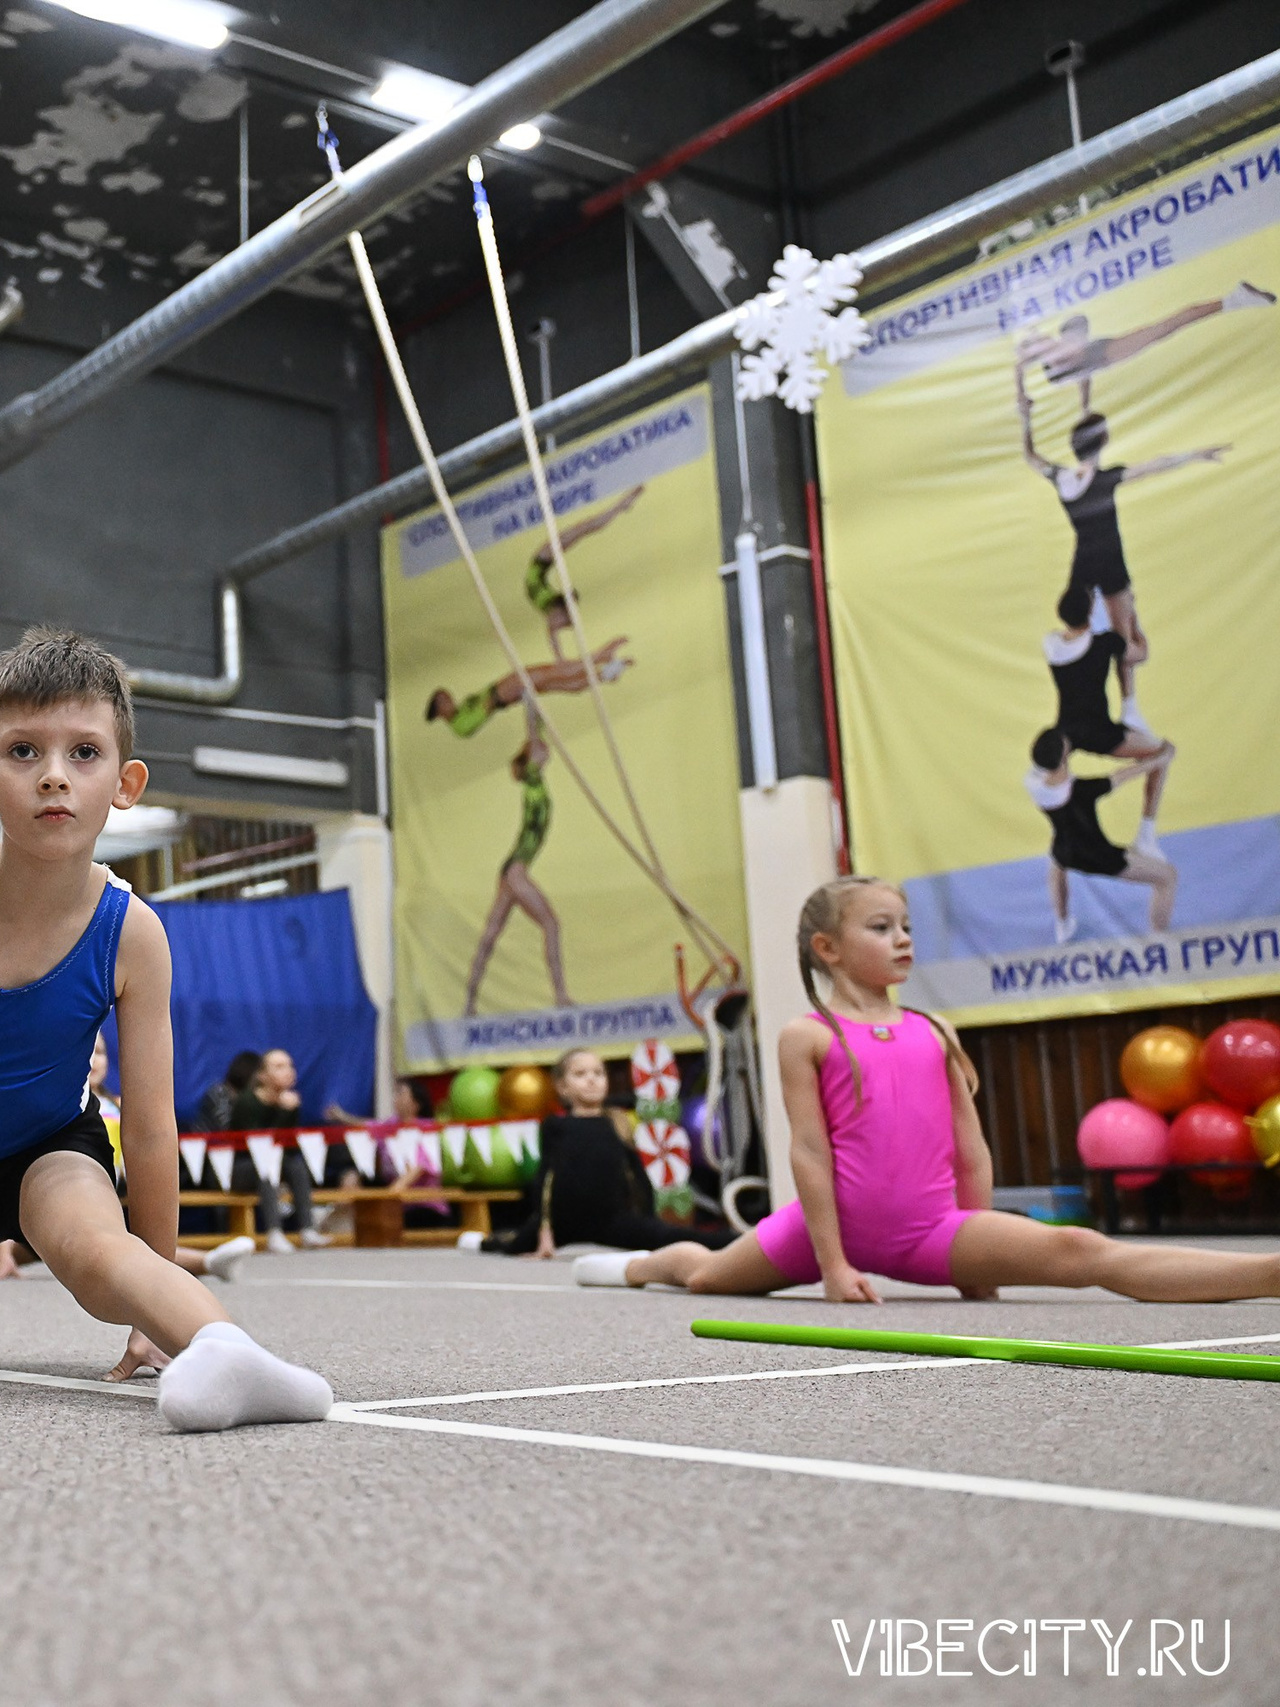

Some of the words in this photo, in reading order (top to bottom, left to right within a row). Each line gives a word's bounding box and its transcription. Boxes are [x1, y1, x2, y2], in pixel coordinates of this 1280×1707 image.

[1083, 145, 1280, 256] АКРОБАТИ
[997, 297, 1044, 332] НА
[1052, 236, 1174, 311] КОВРЕ
[407, 473, 539, 548] СПОТИВНАЯ
[525, 478, 595, 525] КВРЕ
[990, 943, 1168, 992] МУЖСКАЯ
[1180, 930, 1279, 970] ГРУП
[465, 1012, 575, 1047] ЖЕНСКАЯ
[579, 1004, 677, 1039] ГРУППА
